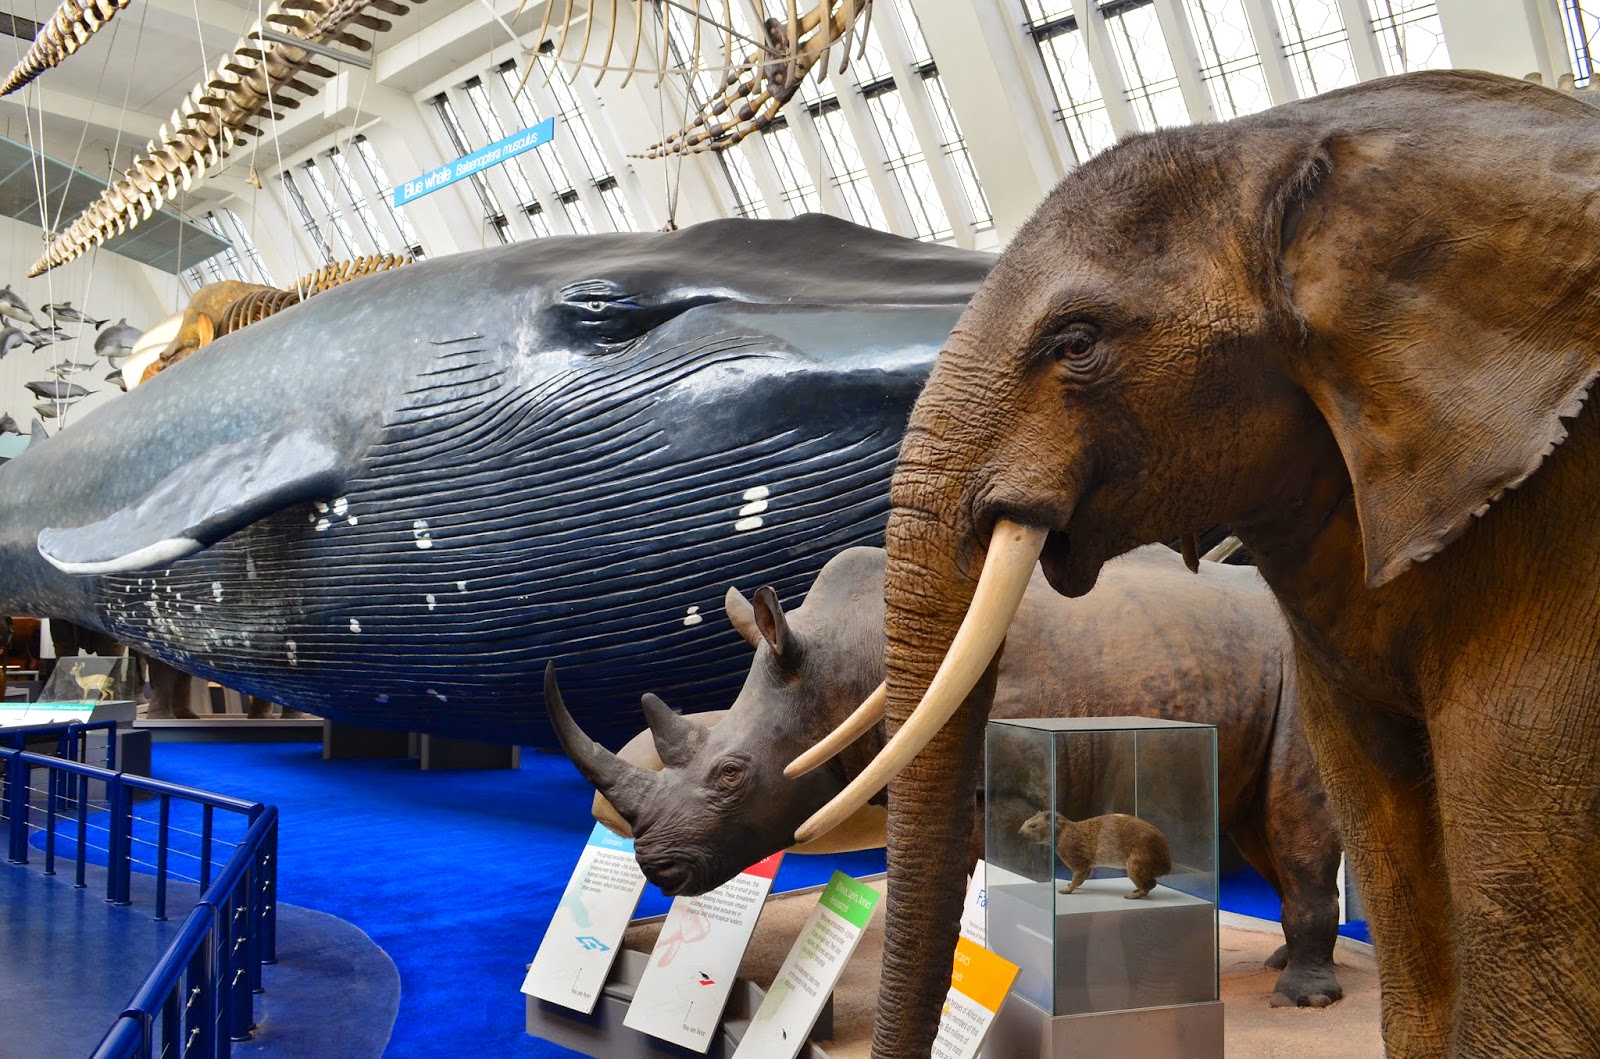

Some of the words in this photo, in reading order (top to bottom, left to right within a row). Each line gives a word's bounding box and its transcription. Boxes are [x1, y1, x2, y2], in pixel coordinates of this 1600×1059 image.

[456, 148, 501, 176] Balaenoptera
[503, 132, 538, 156] musculus
[404, 181, 424, 199] Blue
[425, 167, 451, 191] whale
